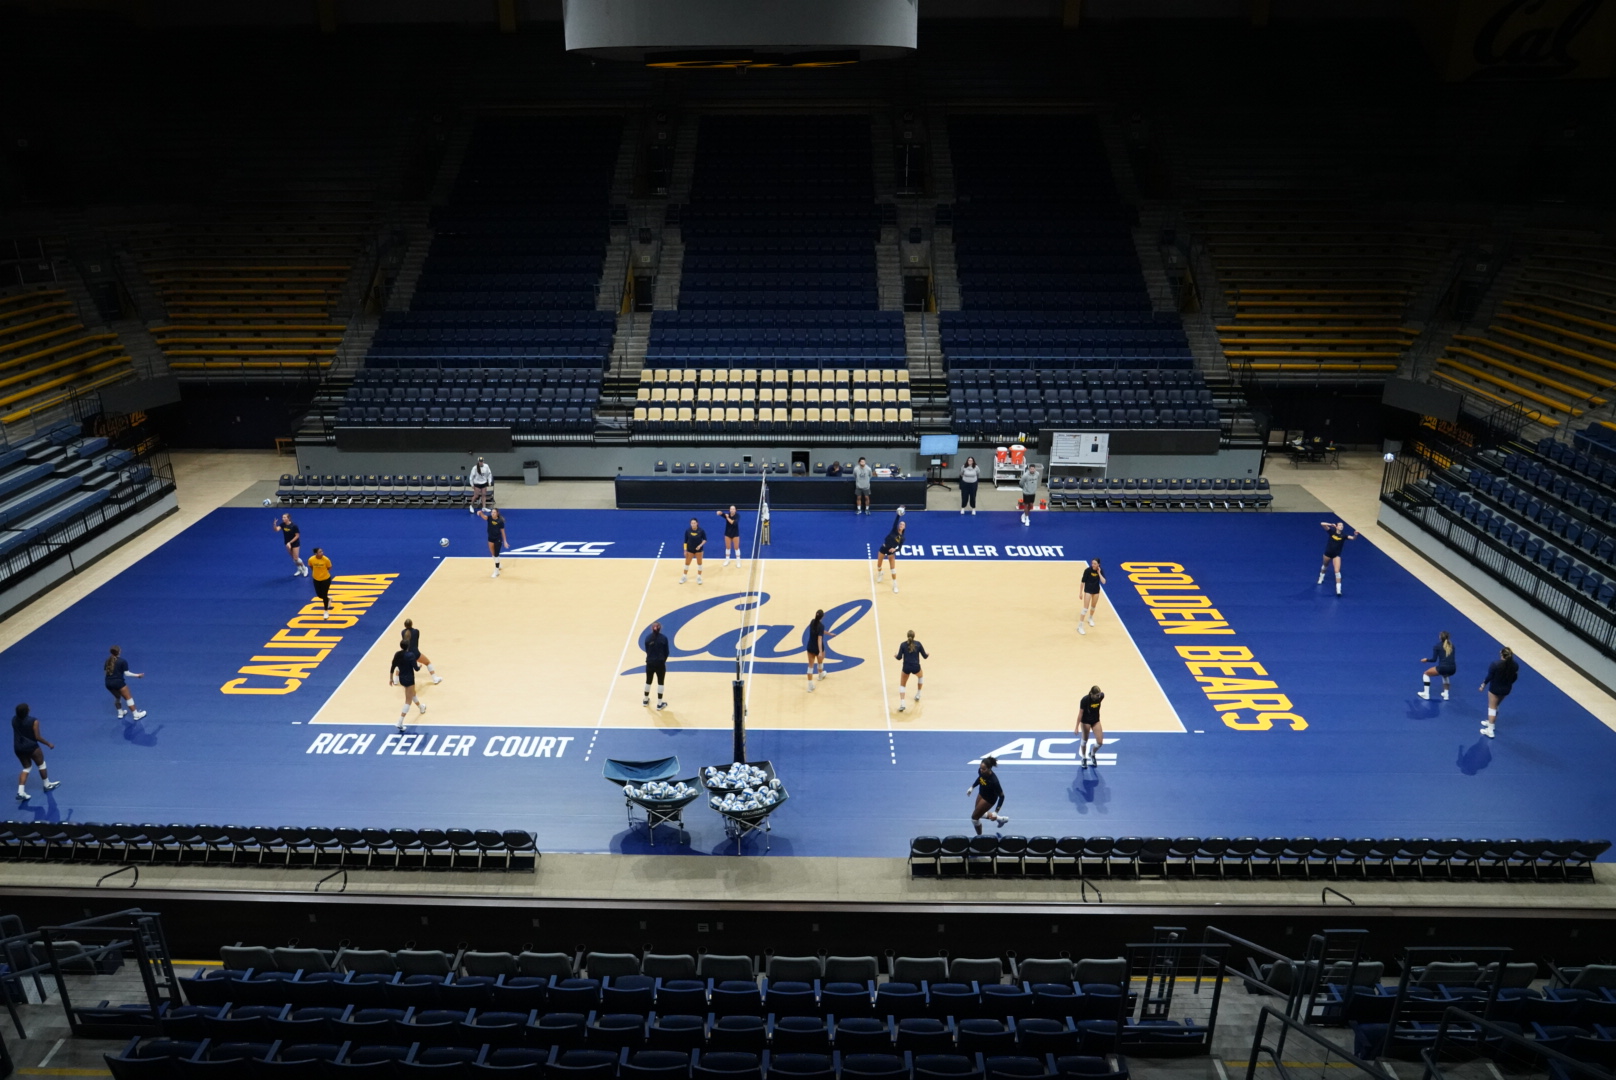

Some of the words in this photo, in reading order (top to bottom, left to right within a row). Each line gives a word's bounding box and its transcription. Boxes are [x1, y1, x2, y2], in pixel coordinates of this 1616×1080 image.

[510, 541, 616, 553] ACC
[931, 545, 999, 557] FELLER
[1004, 545, 1065, 557] COURT
[1120, 561, 1237, 635] GOLDEN
[220, 573, 401, 695] CALIFORNIA
[630, 591, 873, 674] Cal
[1174, 646, 1309, 731] BEARS
[306, 732, 376, 754] RICH
[376, 733, 477, 757] FELLER
[482, 735, 575, 758] COURT
[980, 738, 1121, 759] ACC
